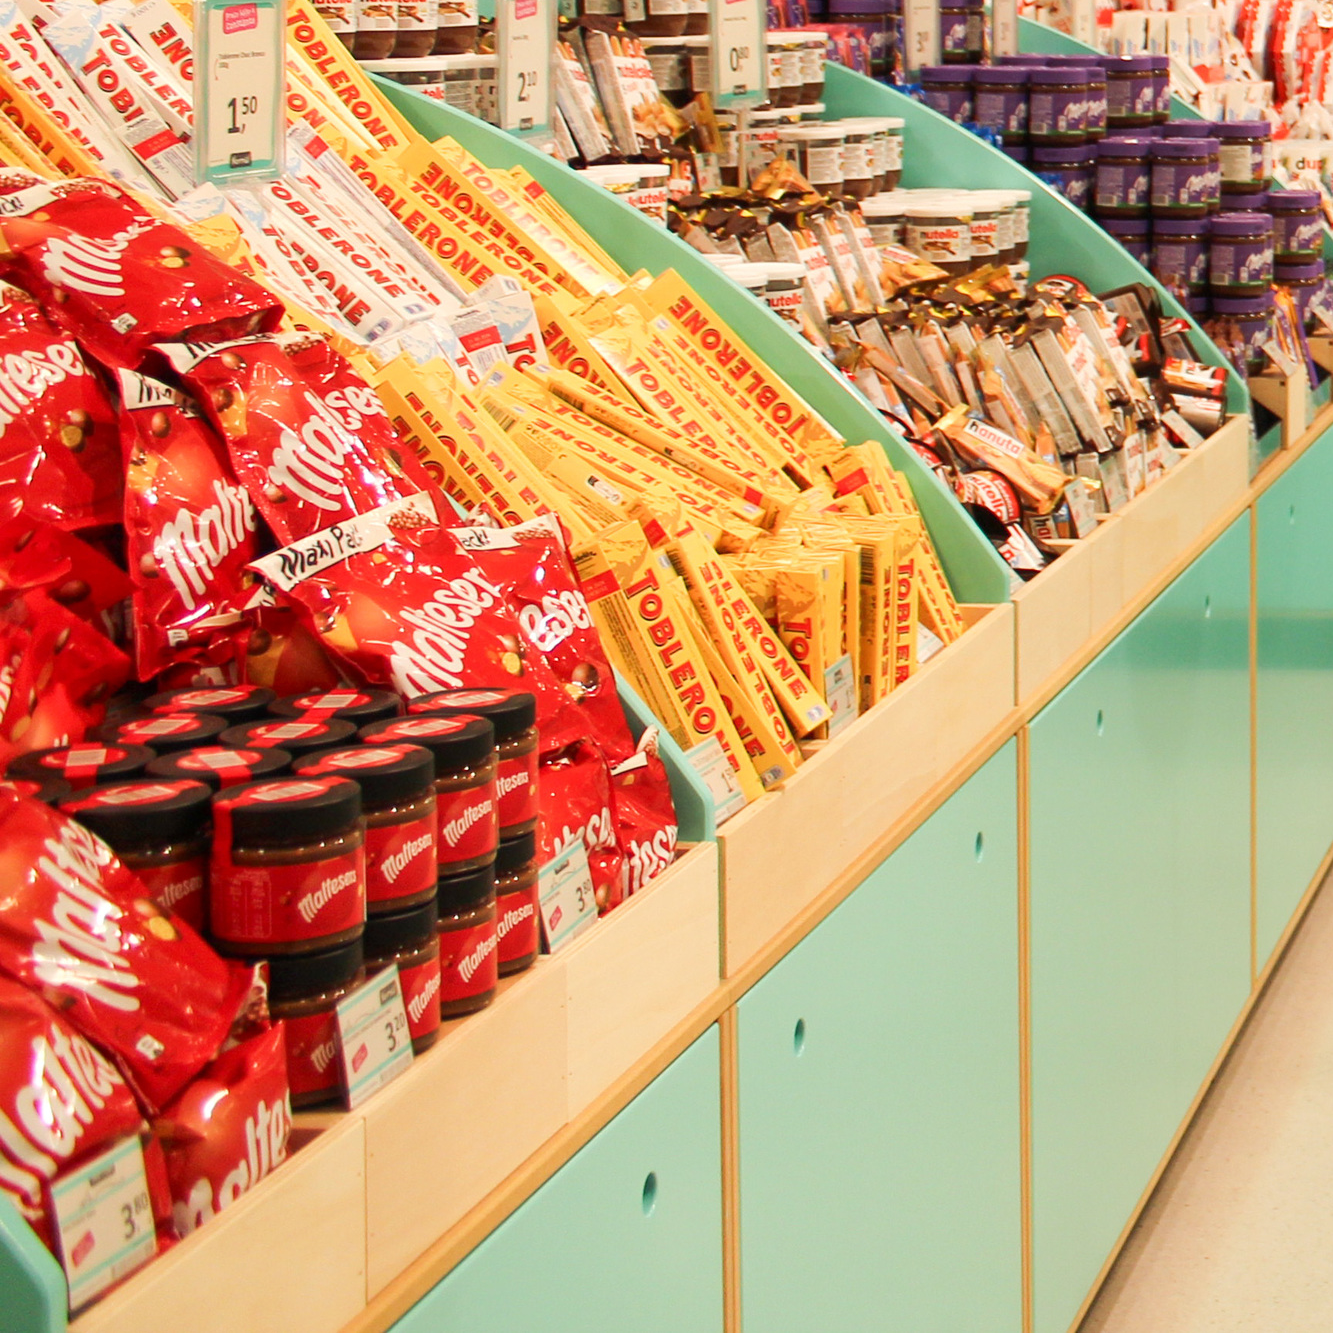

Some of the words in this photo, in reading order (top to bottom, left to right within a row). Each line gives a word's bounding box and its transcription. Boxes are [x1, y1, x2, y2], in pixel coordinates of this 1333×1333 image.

[287, 8, 398, 152] TOBLERONE
[350, 155, 494, 288] TOBLERONE
[408, 181, 559, 297] TOBLERONE
[668, 295, 809, 437] TOBLERONE
[673, 335, 808, 468] TOBLERONE
[553, 403, 734, 502] TOBLERONE
[581, 383, 757, 482] TOBLERONE
[967, 421, 1023, 455] hanuta
[278, 538, 334, 581] Maxi
[298, 870, 358, 924] Maltesers
